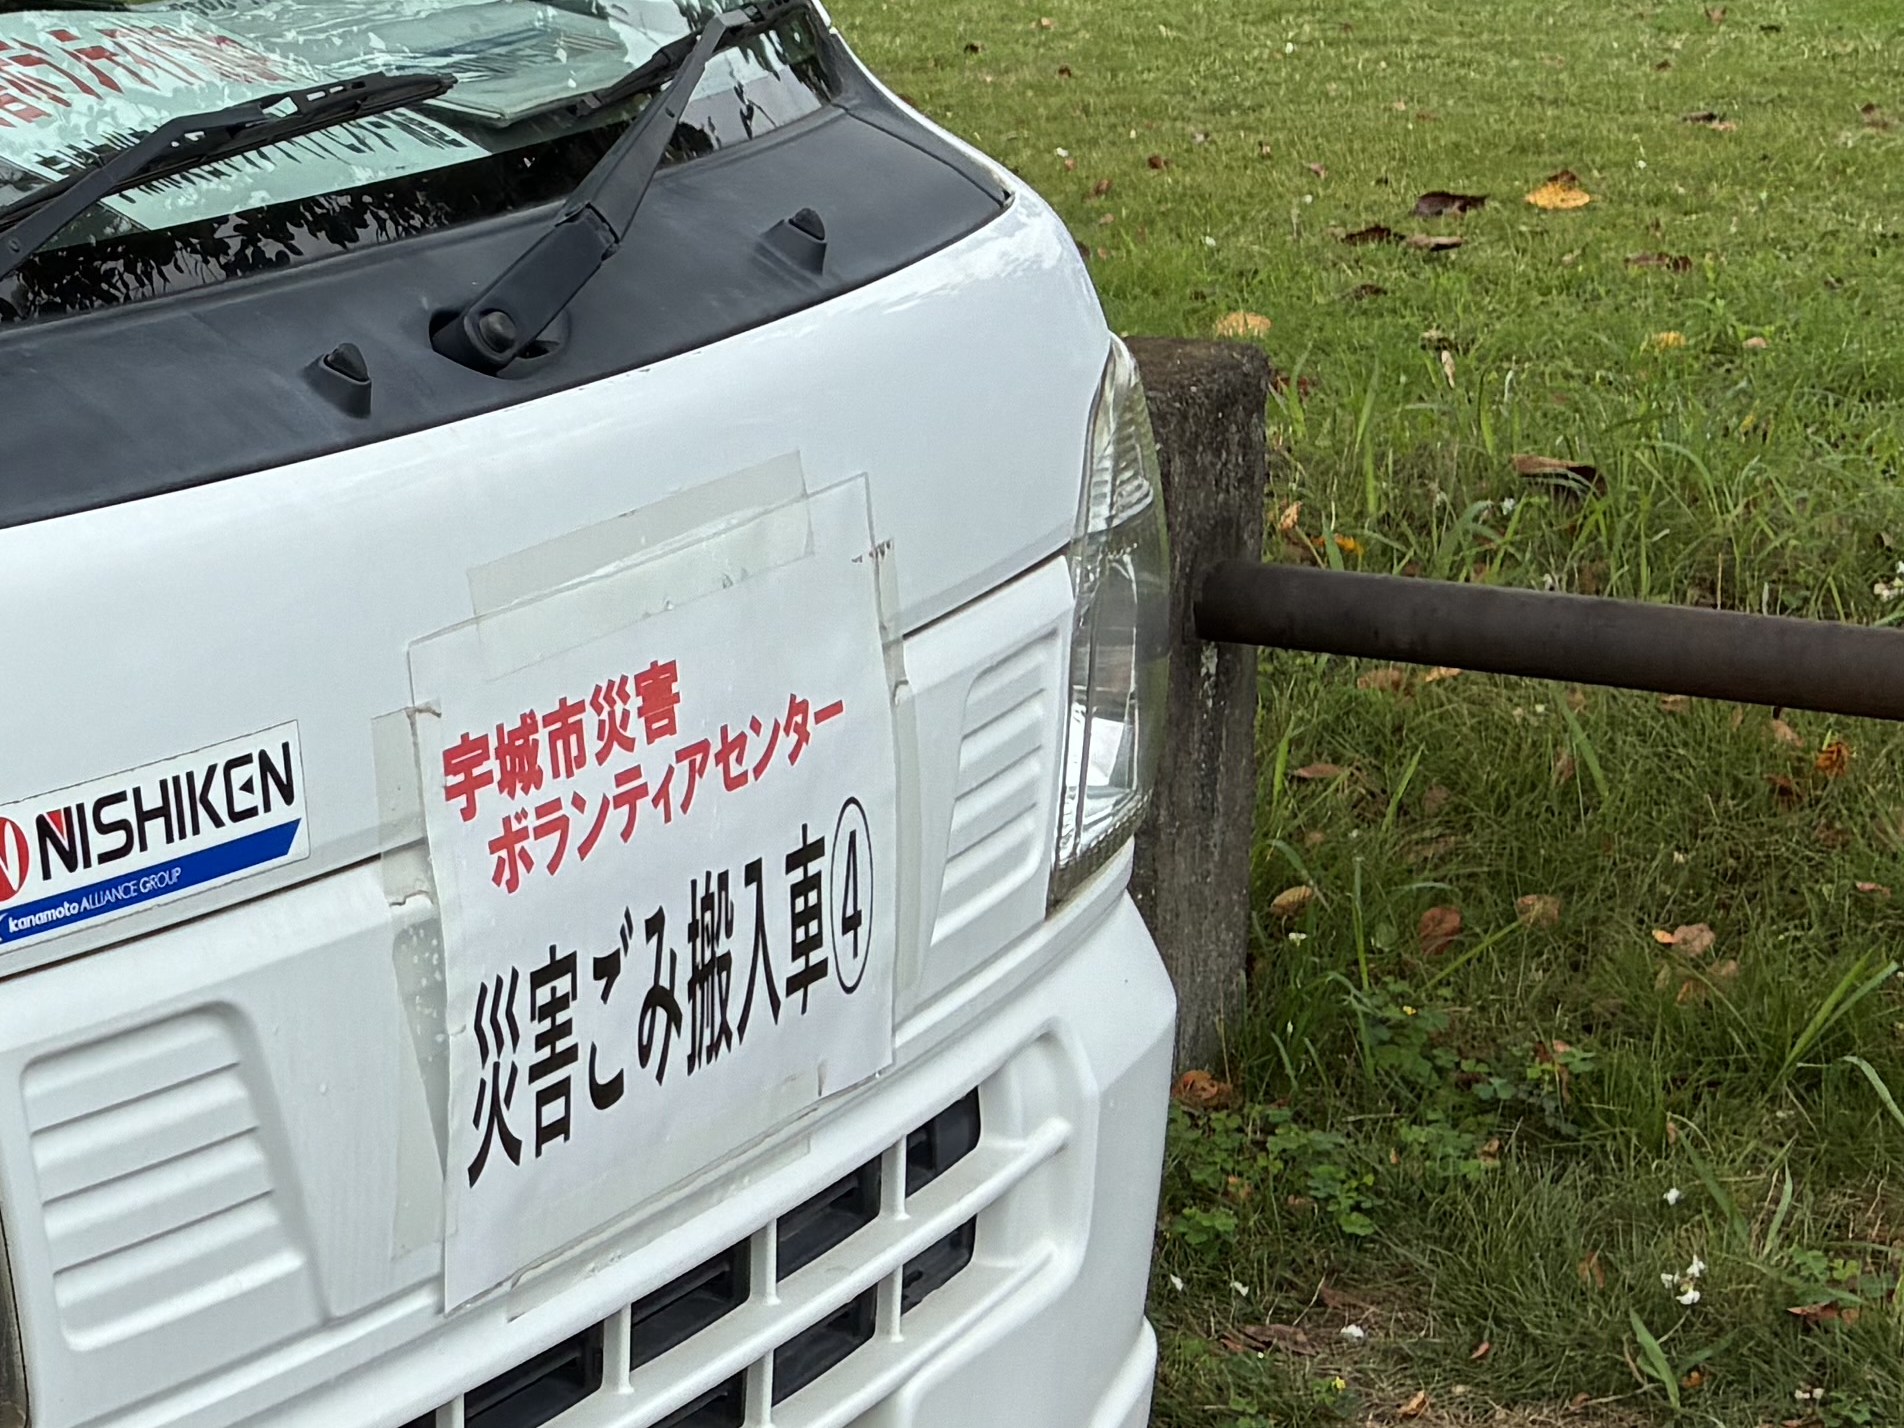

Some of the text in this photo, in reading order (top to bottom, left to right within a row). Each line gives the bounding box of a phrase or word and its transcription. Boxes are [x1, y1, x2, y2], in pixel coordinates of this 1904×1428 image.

[35, 740, 295, 882] NISHIKEN
[441, 660, 682, 823] 宇城市災害
[488, 695, 845, 894] ボランティアセンター
[7, 866, 182, 933] kanamoto ALLIANCE GROUP
